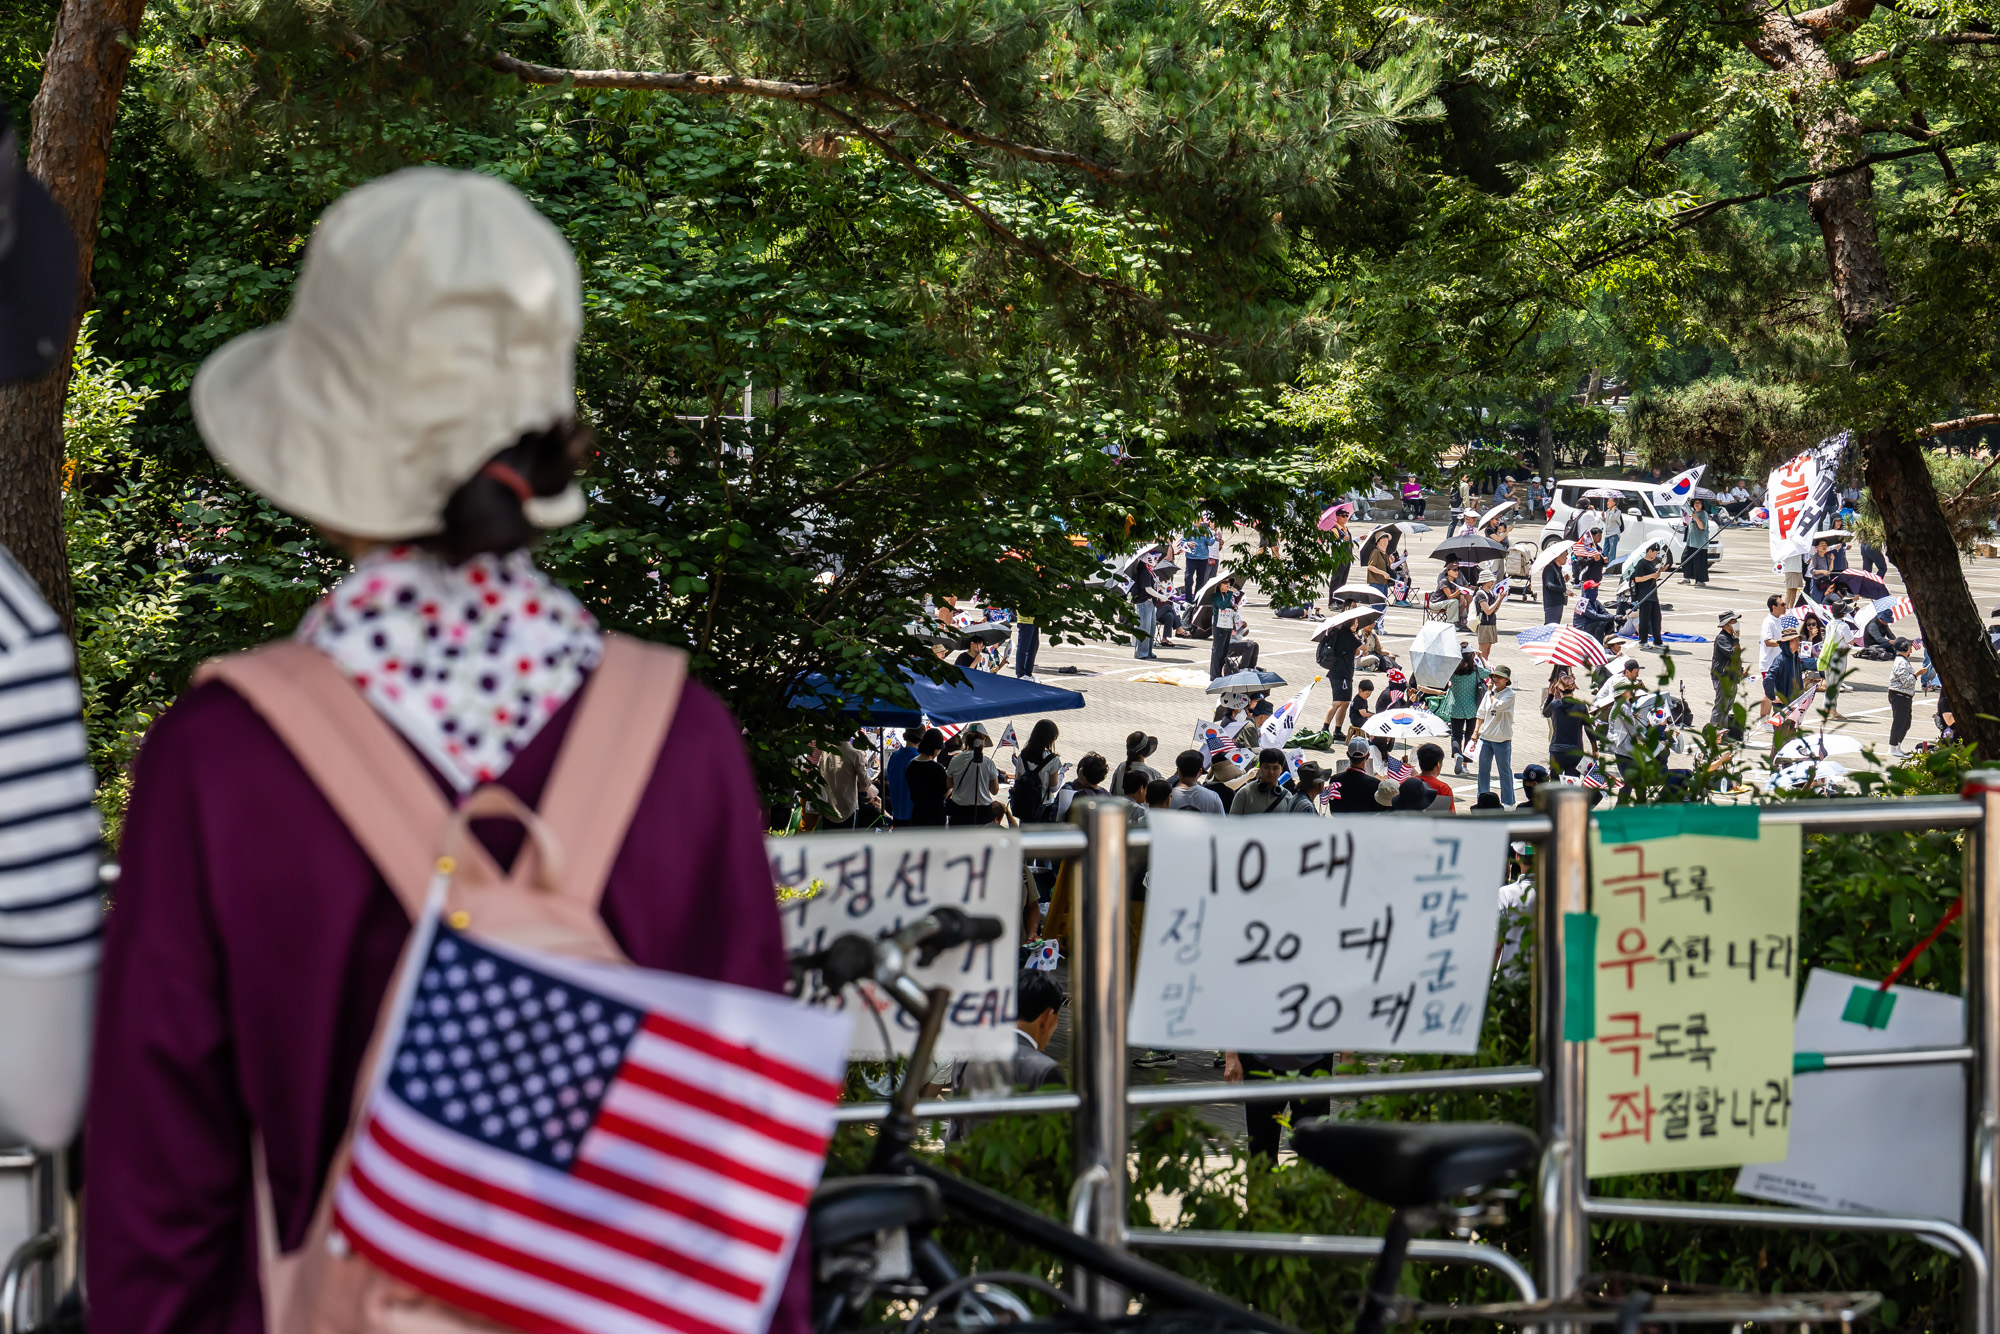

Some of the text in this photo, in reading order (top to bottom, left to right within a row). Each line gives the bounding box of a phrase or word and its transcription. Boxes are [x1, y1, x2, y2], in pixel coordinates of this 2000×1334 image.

[1209, 829, 1355, 908] 10 대
[1235, 904, 1394, 983] 20 대
[1272, 981, 1416, 1045] 30 대
